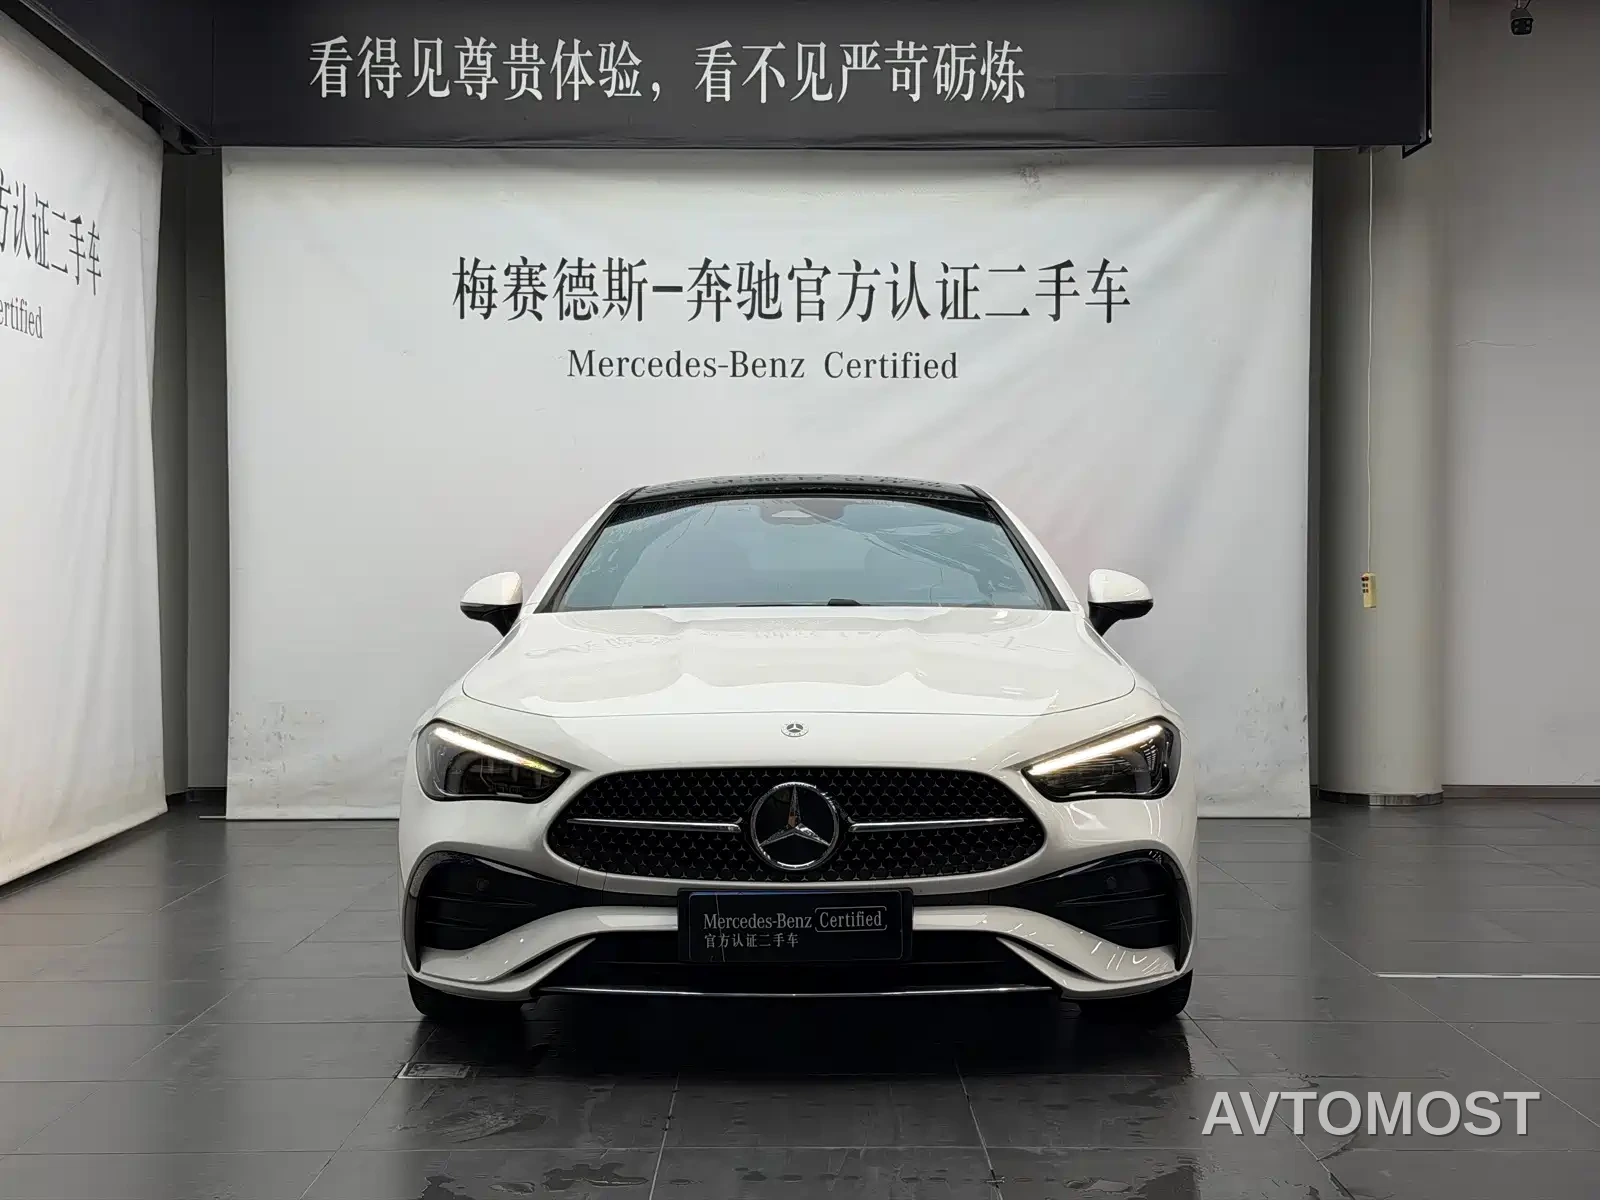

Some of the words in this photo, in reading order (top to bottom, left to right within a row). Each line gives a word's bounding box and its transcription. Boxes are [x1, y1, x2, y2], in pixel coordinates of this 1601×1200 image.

[308, 35, 1026, 104] 看得见尊贵体验，看不见严苛砺炼
[566, 349, 805, 380] Mercedes-Benz
[824, 351, 959, 380] Certified
[703, 912, 812, 931] Mercedes-Benz
[819, 910, 882, 929] Certified
[704, 933, 799, 949] 官方认证二手车
